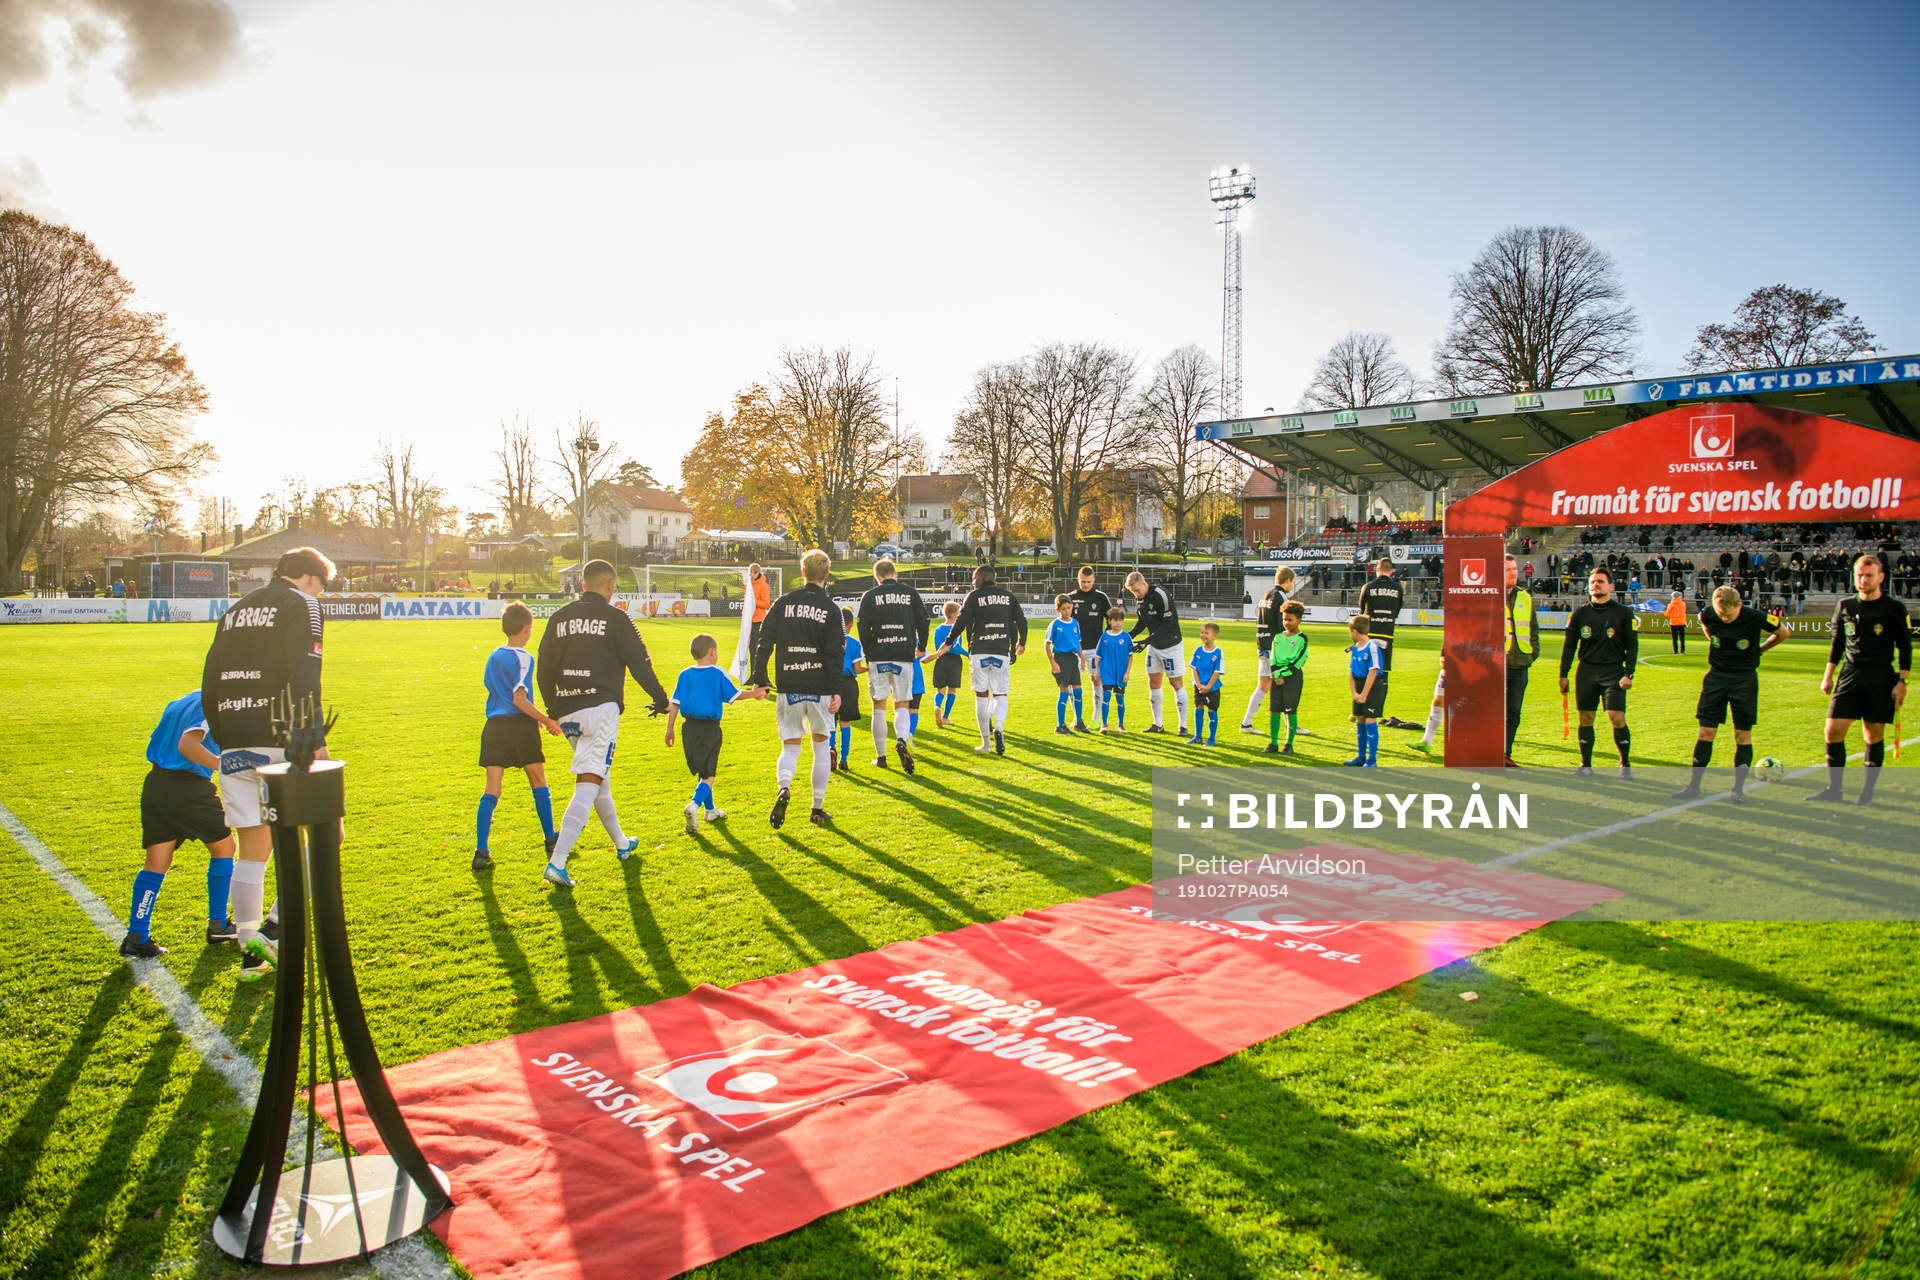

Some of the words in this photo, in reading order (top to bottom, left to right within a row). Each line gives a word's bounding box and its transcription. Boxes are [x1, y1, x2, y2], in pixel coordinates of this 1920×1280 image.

[1679, 368, 1856, 397] FRAMTIDEN
[1514, 394, 1542, 406] MTA
[1583, 387, 1614, 401] MTA
[1390, 407, 1414, 418] MTA
[1450, 401, 1476, 413] MTA
[1281, 417, 1303, 428] MTA
[1334, 411, 1357, 423] MTA
[1231, 422, 1252, 433] MTA
[1668, 461, 1724, 474] SVENSKA
[1727, 460, 1758, 472] SPEL
[1550, 486, 1640, 517] Framåt
[1645, 485, 1685, 514] för
[1687, 481, 1781, 513] svensk
[1787, 477, 1902, 511] fotboll!
[875, 594, 885, 606] IK
[885, 593, 911, 605] BRAGE
[234, 606, 279, 628] BRAGE
[384, 601, 481, 617] MATAKI
[784, 604, 796, 618] IK
[796, 604, 828, 624] BRAGE
[556, 621, 569, 638] IK
[569, 618, 607, 636] BRAGE
[1121, 905, 1268, 941] SVENSKA
[1274, 938, 1364, 964] SPEL
[886, 969, 1056, 1027] Framåt
[1033, 1015, 1134, 1048] för
[927, 1016, 1137, 1088] fotboll!
[530, 1052, 678, 1139] SVENSKA
[660, 1132, 766, 1194] SPEL
